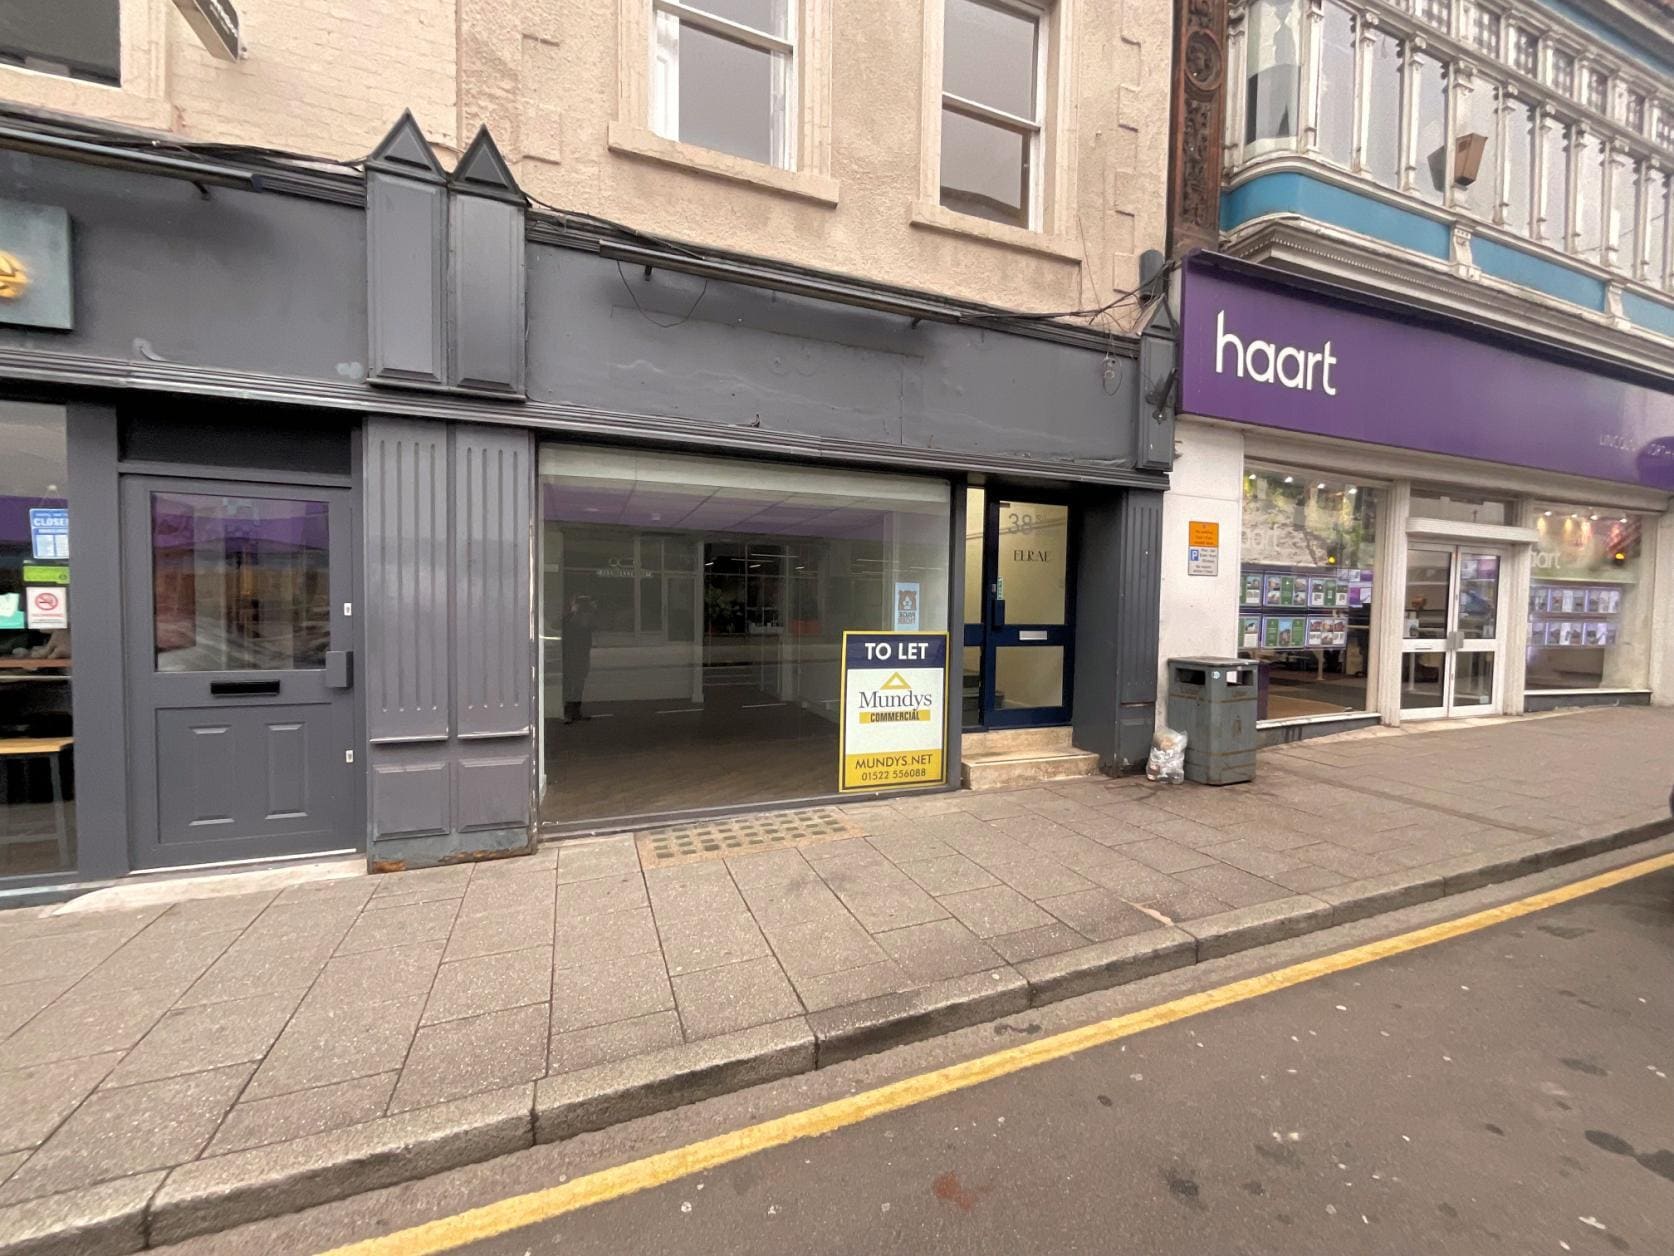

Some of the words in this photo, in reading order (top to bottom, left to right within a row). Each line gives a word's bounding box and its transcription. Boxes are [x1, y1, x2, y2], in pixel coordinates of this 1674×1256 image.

[1216, 310, 1337, 396] haart
[33, 518, 69, 527] CLOSE
[1009, 513, 1032, 535] 38
[864, 643, 892, 660] TO
[898, 643, 928, 659] LET
[858, 690, 932, 710] Mundys
[870, 710, 919, 722] COMMERCIAL
[855, 754, 933, 769] MUNDYS.NET
[861, 771, 889, 781] 01522
[892, 768, 926, 778] 556088
